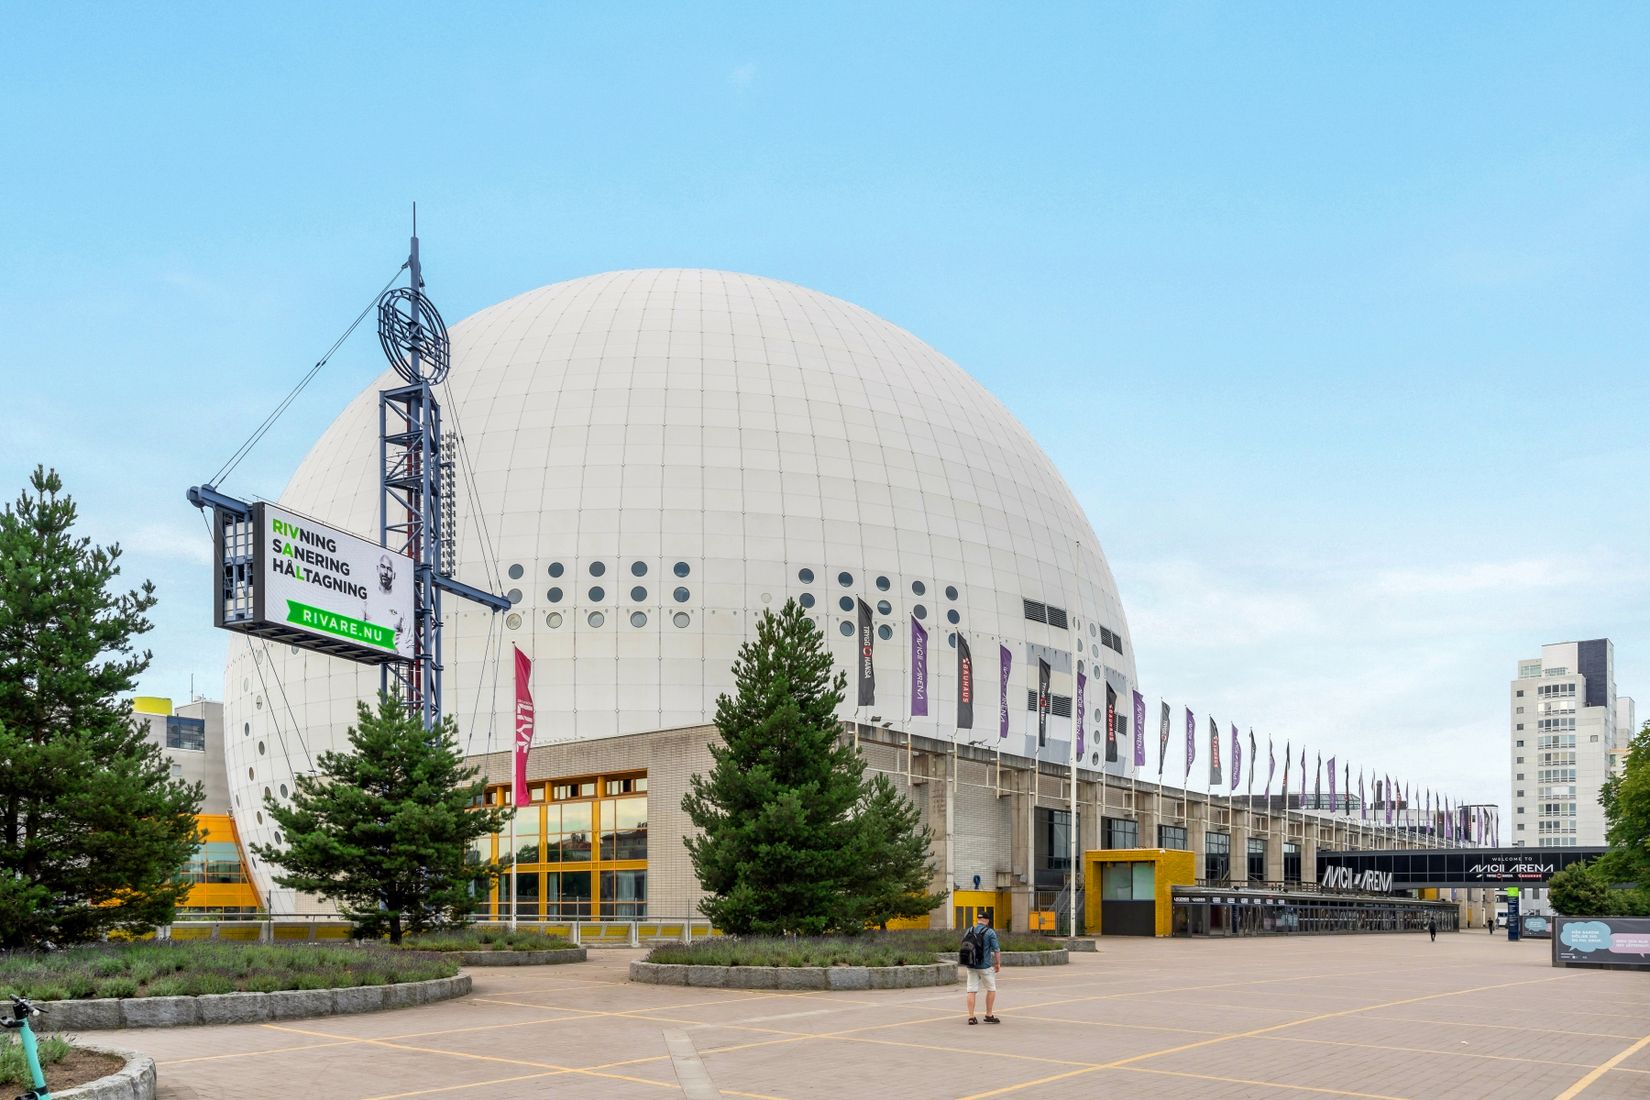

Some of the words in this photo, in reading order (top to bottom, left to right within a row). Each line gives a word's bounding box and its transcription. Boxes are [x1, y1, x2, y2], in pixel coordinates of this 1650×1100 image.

[272, 518, 337, 553] RIVNING
[272, 538, 350, 576] SANERING
[272, 557, 368, 600] HÅLTAGNING
[302, 608, 383, 642] RIVARE.NU
[864, 656, 872, 679] HANSA
[916, 667, 924, 700] ARENA
[1322, 864, 1353, 889] AVICII
[1360, 869, 1393, 893] ARENA
[1468, 863, 1505, 873] AVICII
[1509, 863, 1554, 873] ARENA
